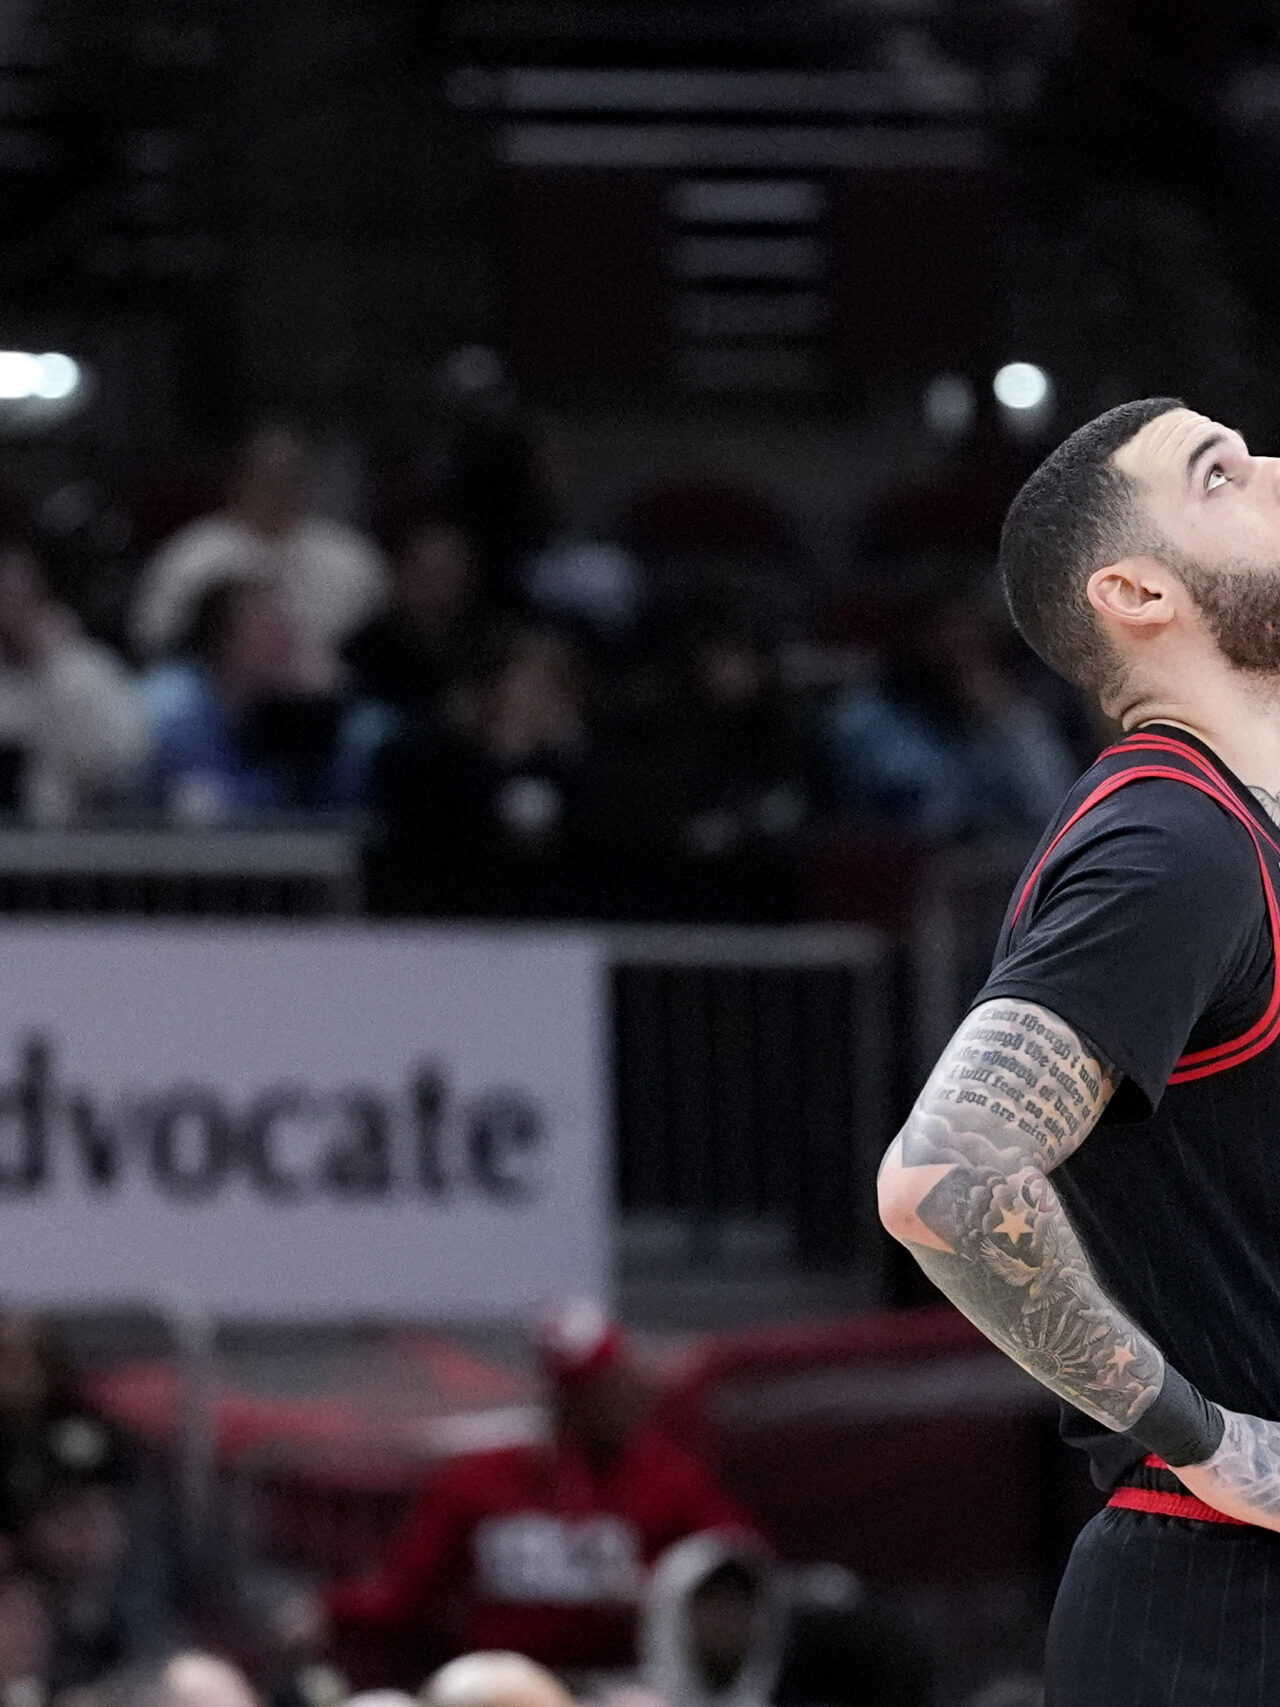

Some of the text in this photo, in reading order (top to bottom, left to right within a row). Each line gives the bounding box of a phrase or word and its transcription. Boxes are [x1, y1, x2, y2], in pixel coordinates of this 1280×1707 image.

[1020, 1013, 1070, 1060] though
[959, 1066, 993, 1083] will
[991, 1075, 1025, 1102] fear
[1025, 1100, 1043, 1119] no
[982, 1051, 1038, 1088] shadow
[1024, 1041, 1049, 1067] the
[1049, 1062, 1084, 1106] valley
[956, 1089, 988, 1107] you
[990, 1101, 1015, 1122] are
